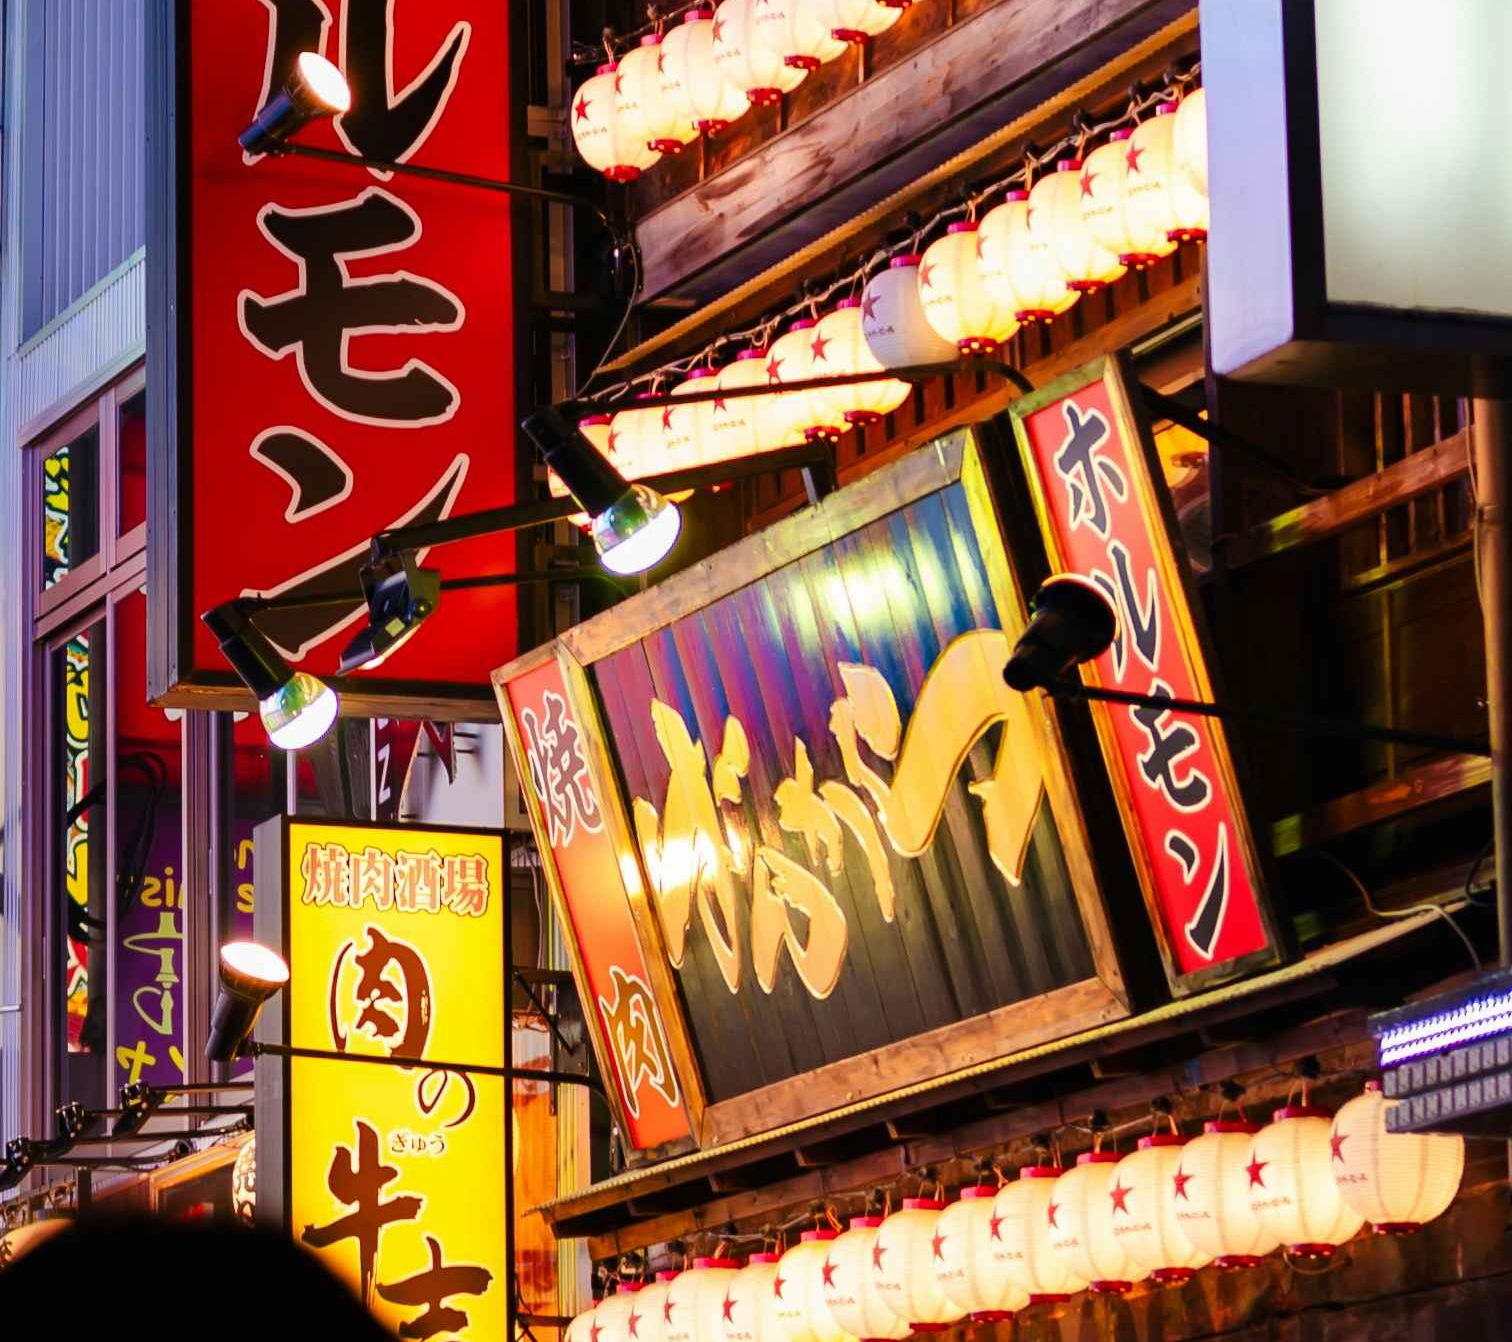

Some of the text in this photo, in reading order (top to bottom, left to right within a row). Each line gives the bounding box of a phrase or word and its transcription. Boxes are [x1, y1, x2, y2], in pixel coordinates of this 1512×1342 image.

[1053, 398, 1232, 961] ホルモン
[302, 842, 489, 918] 焼肉酒場
[523, 688, 679, 1119] 焼肉
[391, 1133, 445, 1155] ぎゅう
